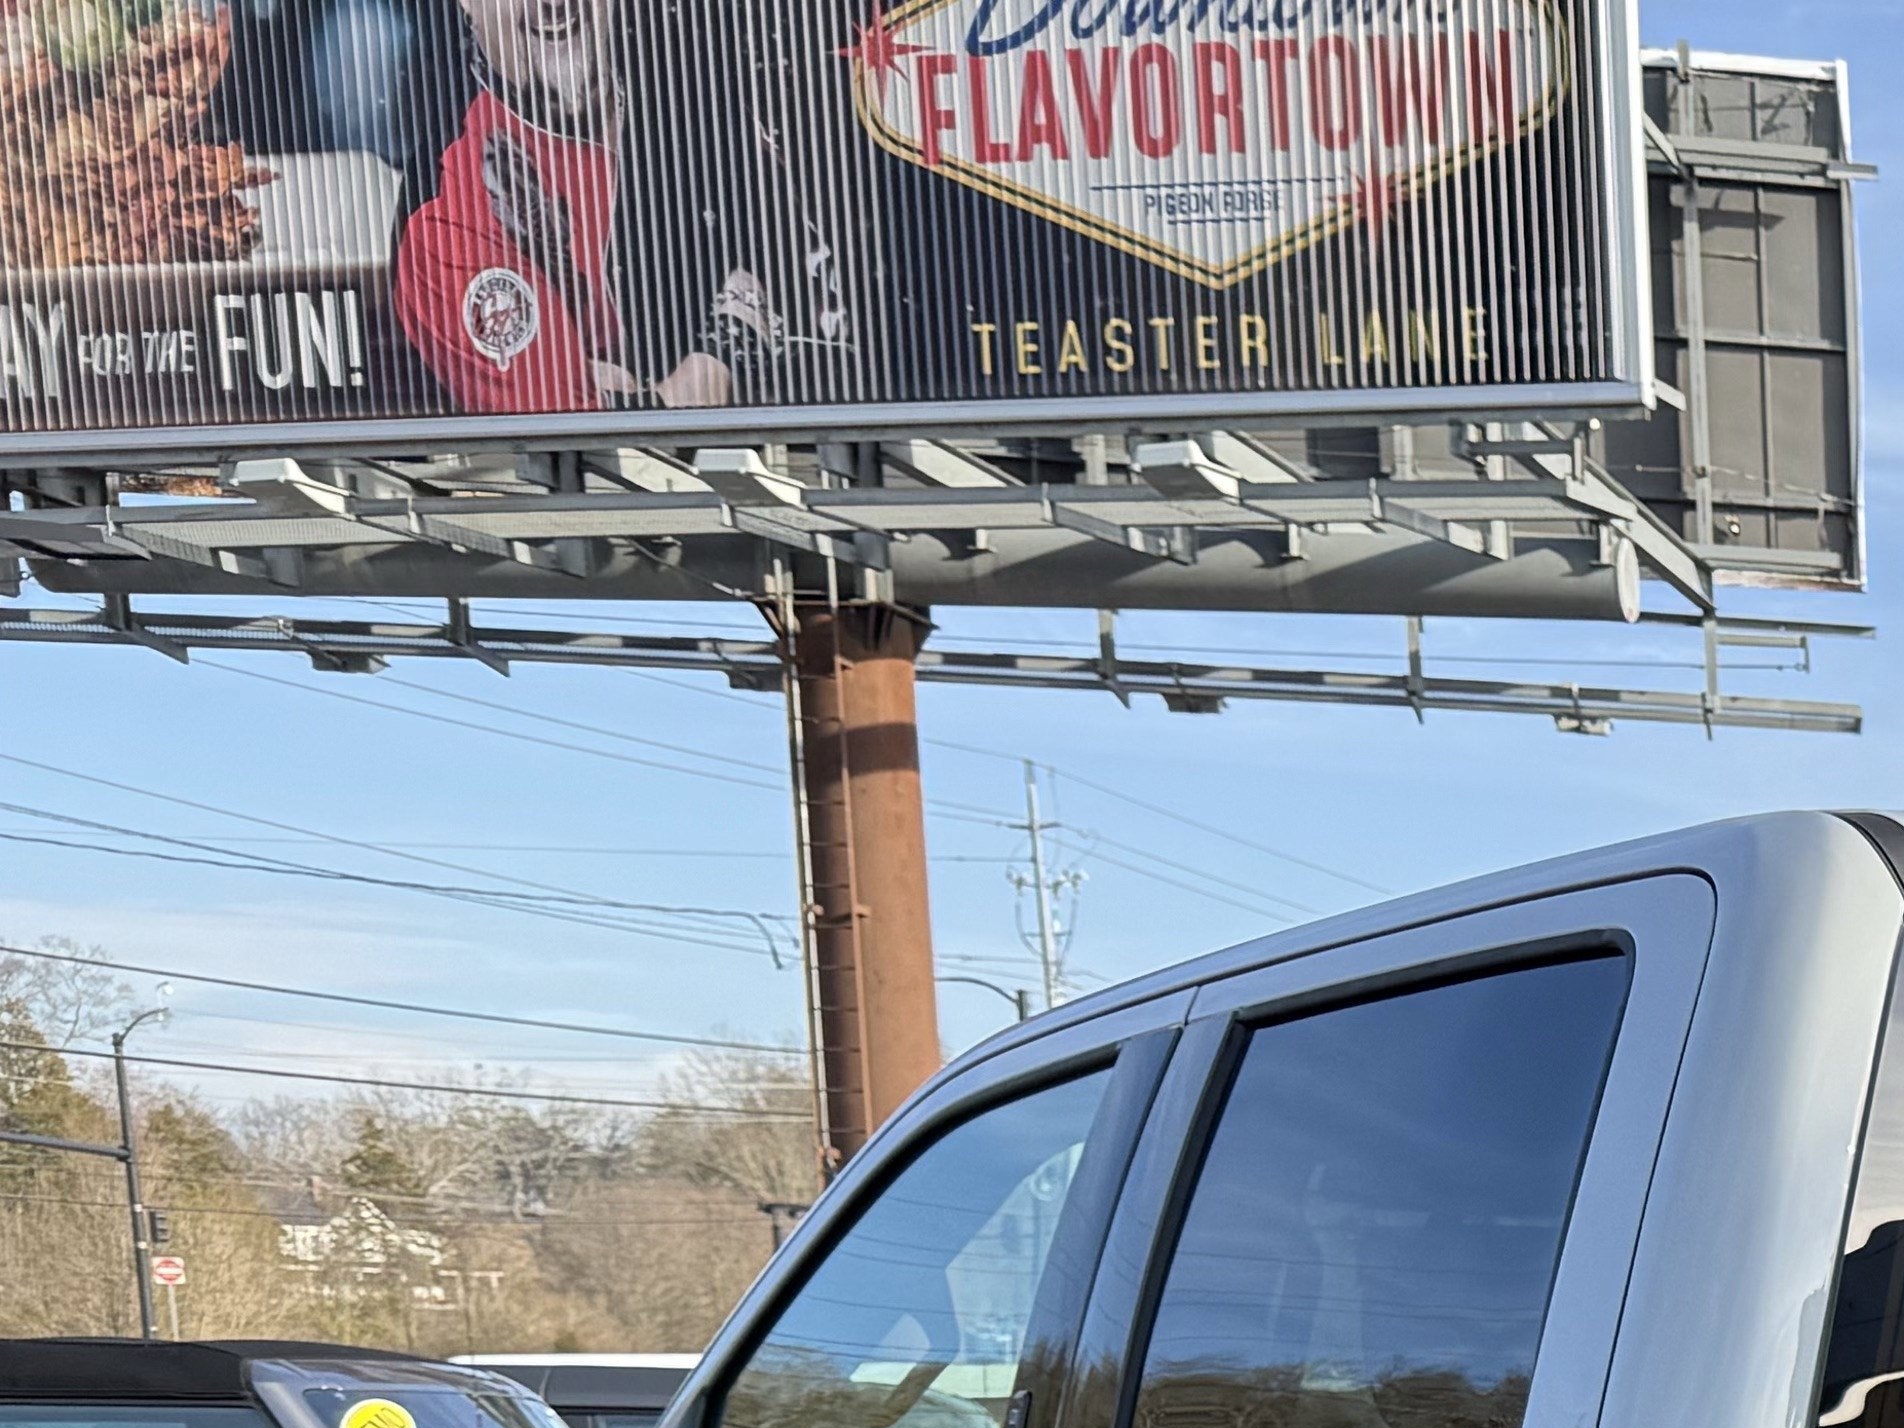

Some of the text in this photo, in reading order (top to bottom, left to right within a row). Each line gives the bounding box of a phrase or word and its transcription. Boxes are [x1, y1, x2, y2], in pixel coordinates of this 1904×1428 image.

[916, 29, 1514, 166] FLAVORTOWN
[1145, 191, 1214, 217] PIGEON
[214, 288, 364, 392] FUN!
[970, 305, 1489, 376] TEASTER LANE
